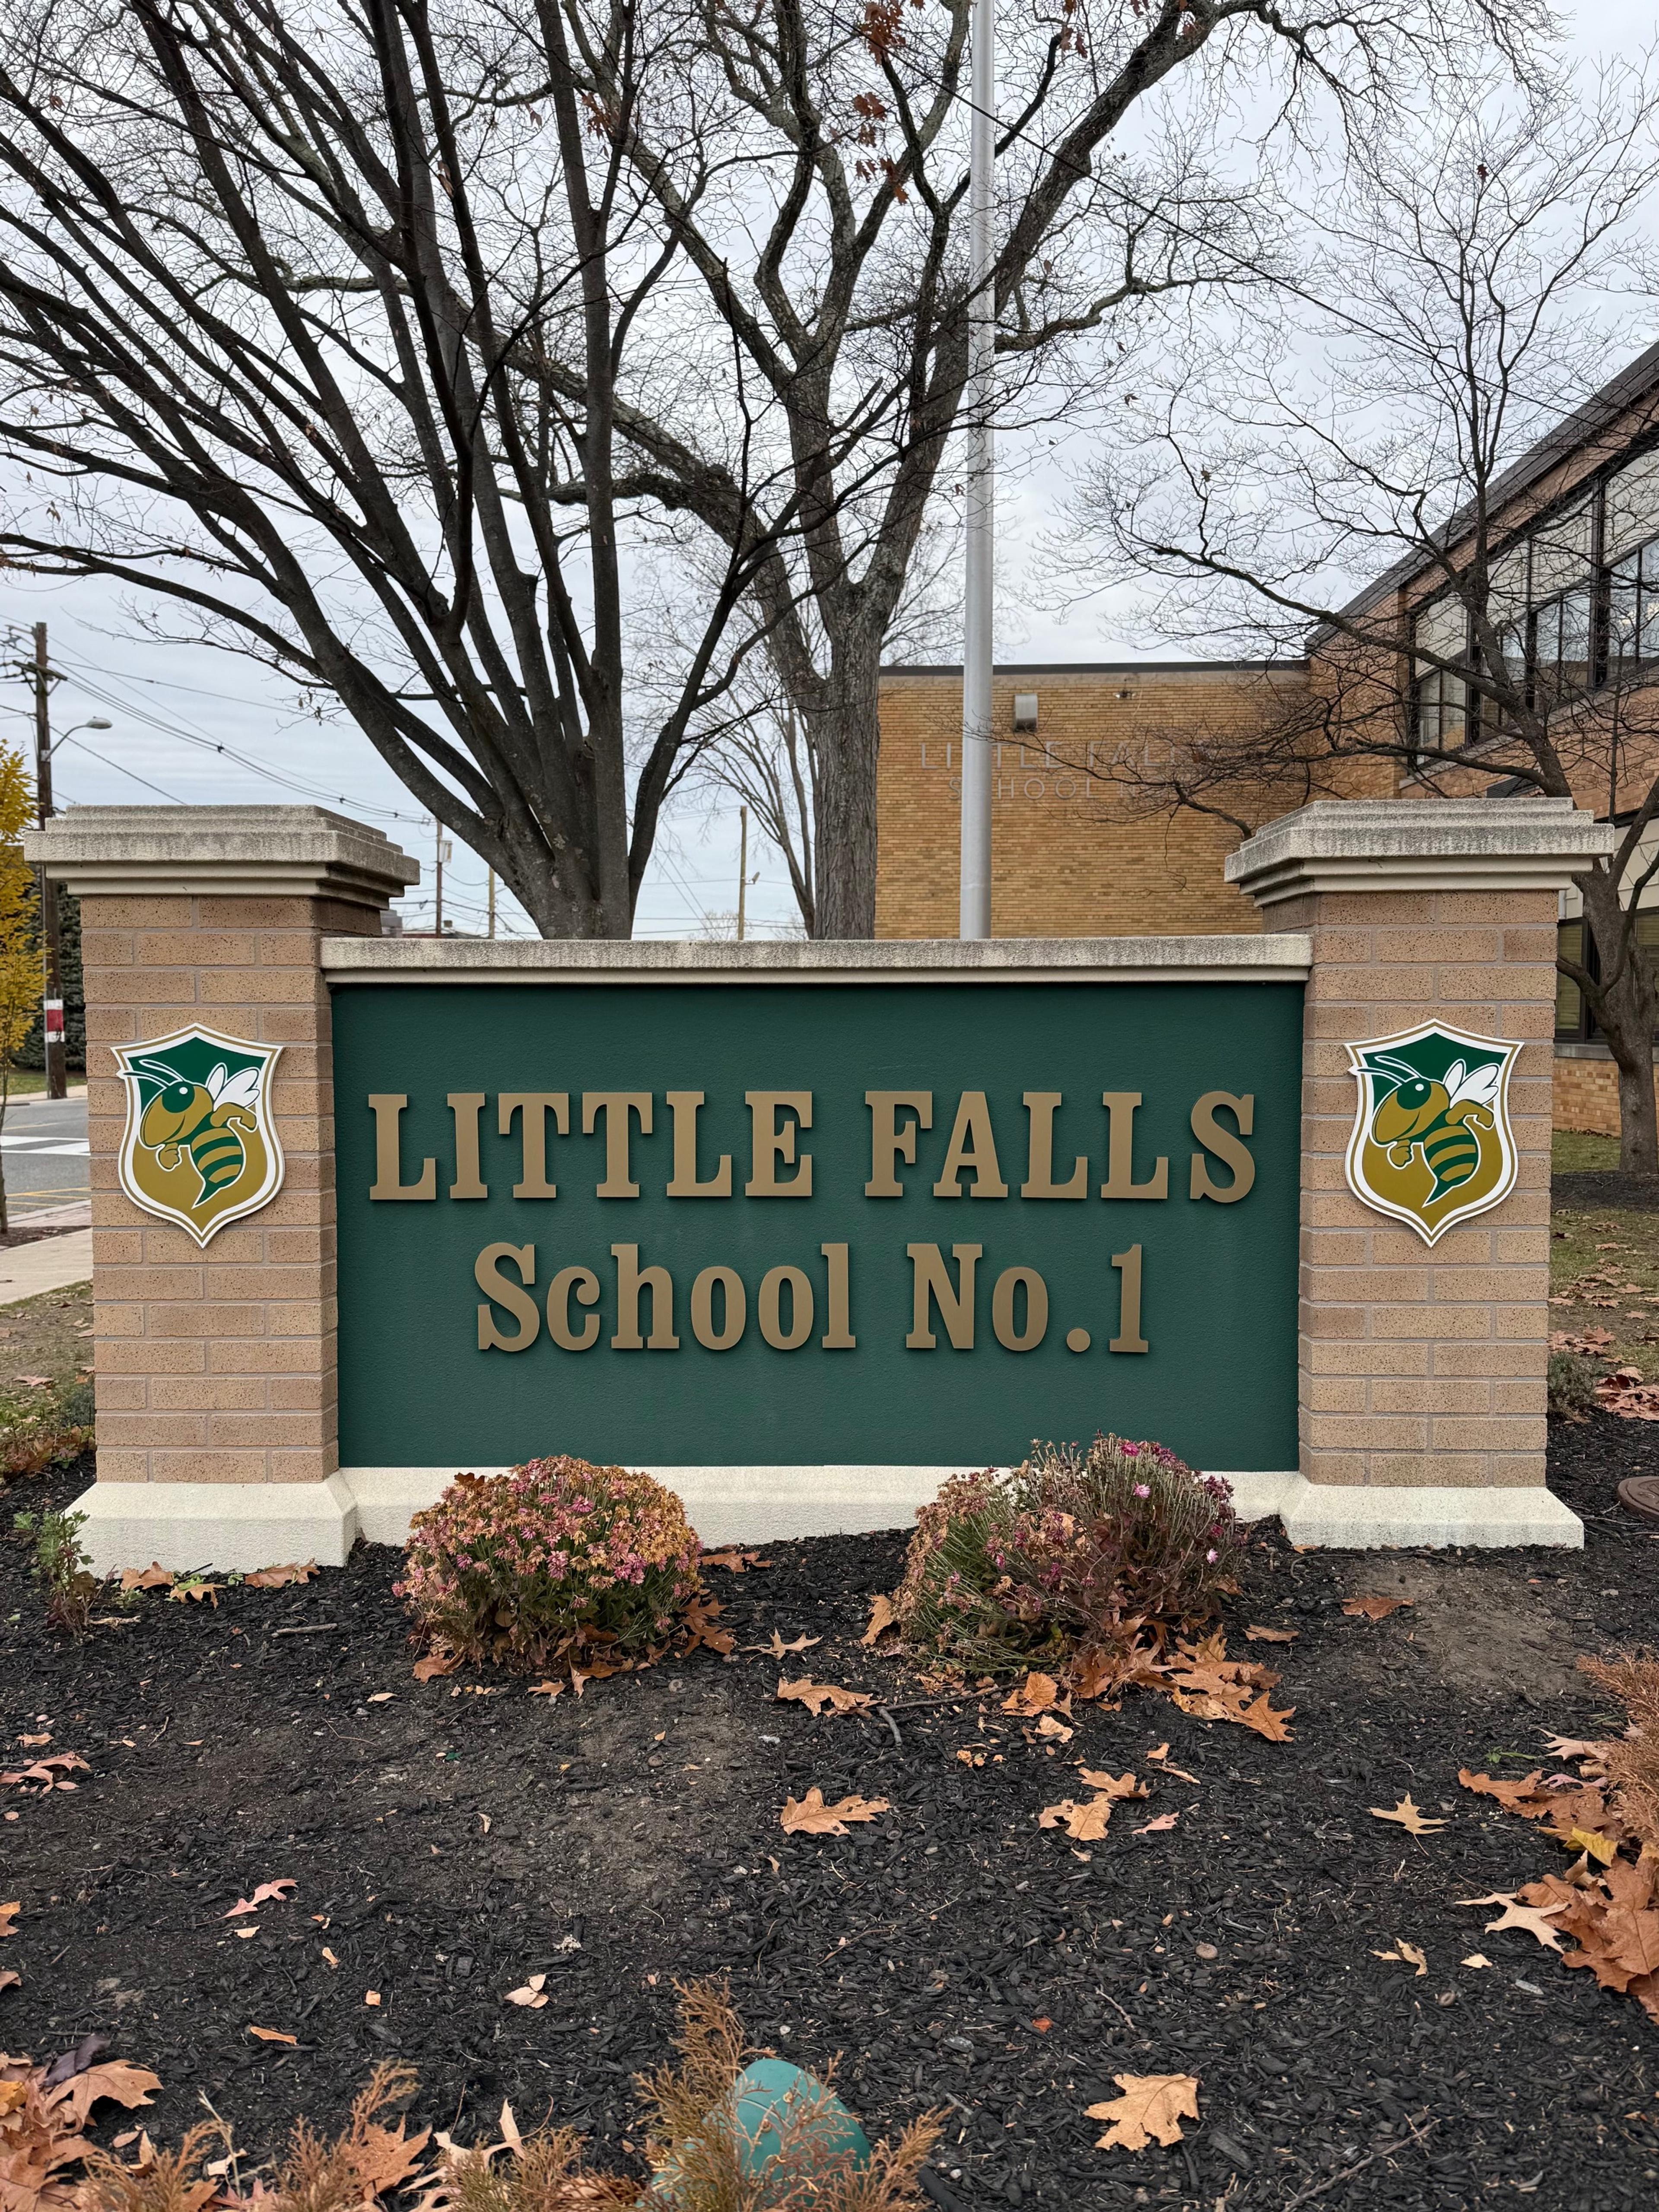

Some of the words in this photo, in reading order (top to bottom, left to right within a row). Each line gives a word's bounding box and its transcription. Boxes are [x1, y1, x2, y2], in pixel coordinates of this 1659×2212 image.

[920, 740, 1068, 770] LITLE
[948, 778, 1100, 800] SHOOL
[368, 1091, 813, 1200] LITTLE
[864, 1091, 1255, 1203] FALLS
[474, 1242, 856, 1352] School
